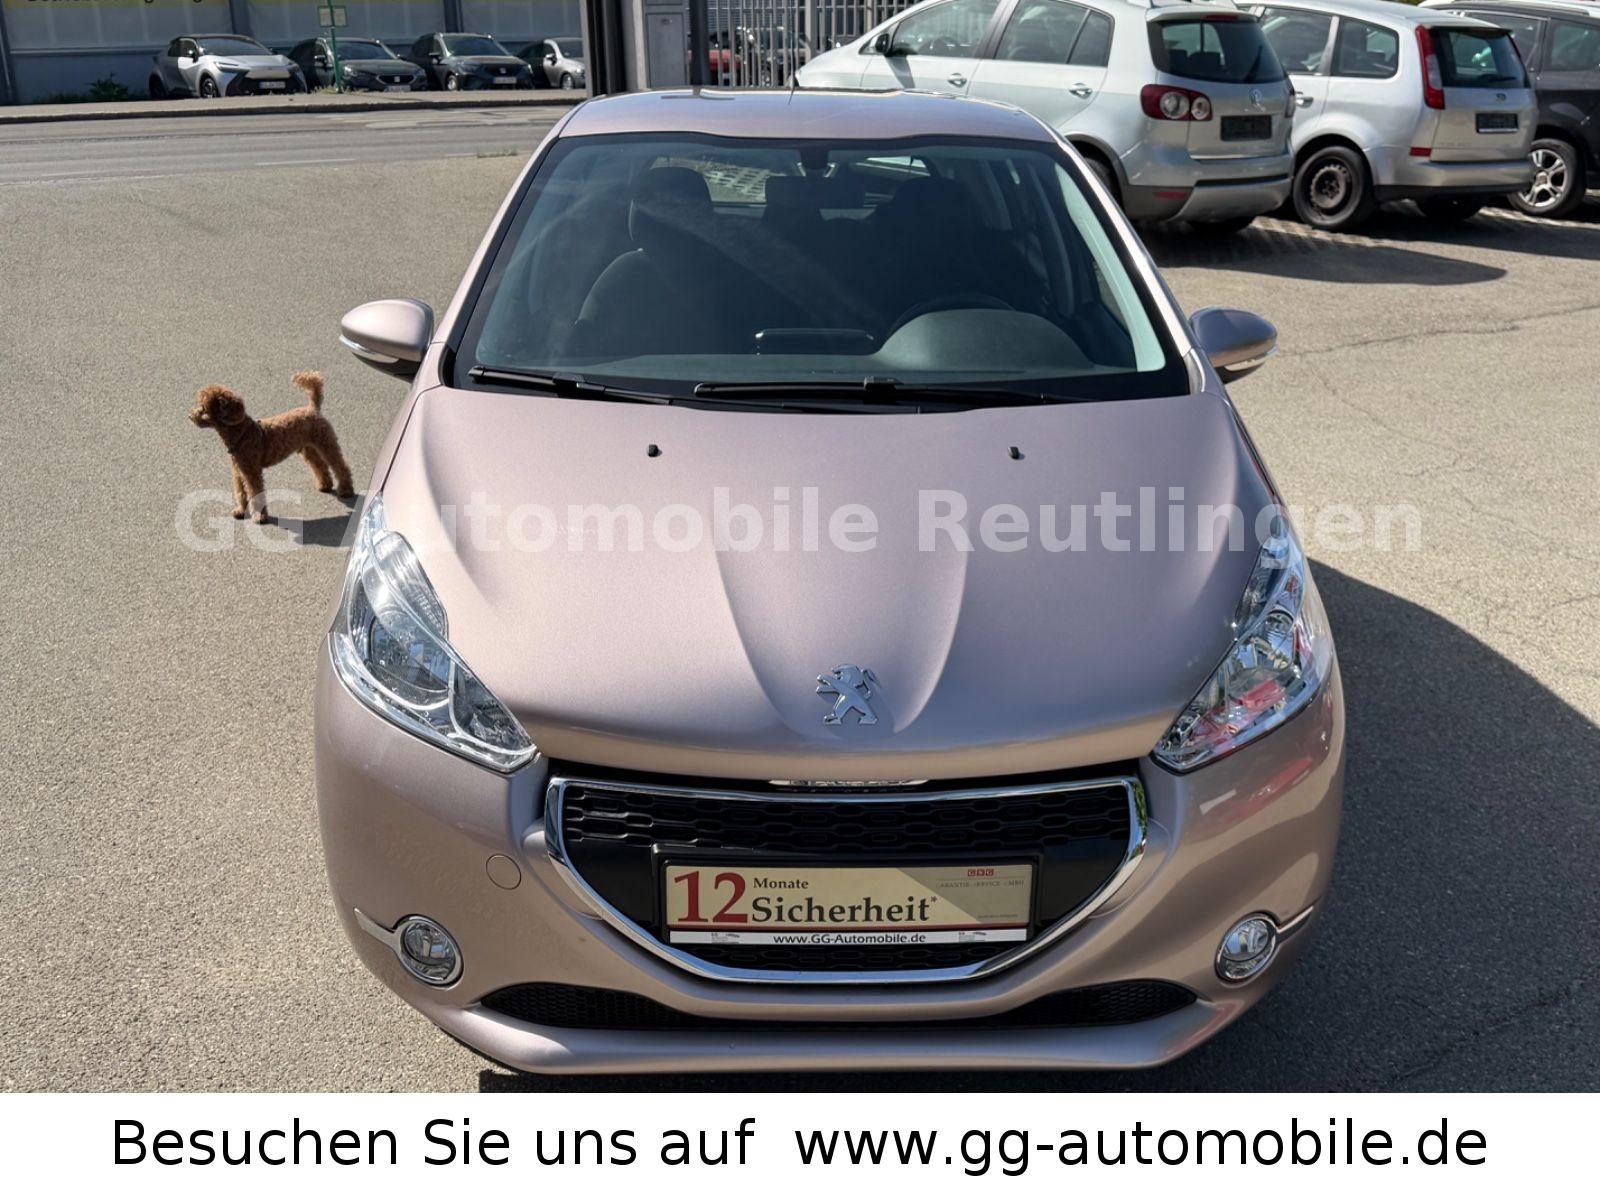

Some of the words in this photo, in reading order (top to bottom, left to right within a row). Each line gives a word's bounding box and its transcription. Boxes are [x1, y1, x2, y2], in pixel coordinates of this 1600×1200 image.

[753, 877, 809, 889] Monate
[674, 870, 748, 923] 12
[773, 933, 926, 945] www.GG-Automobile.de
